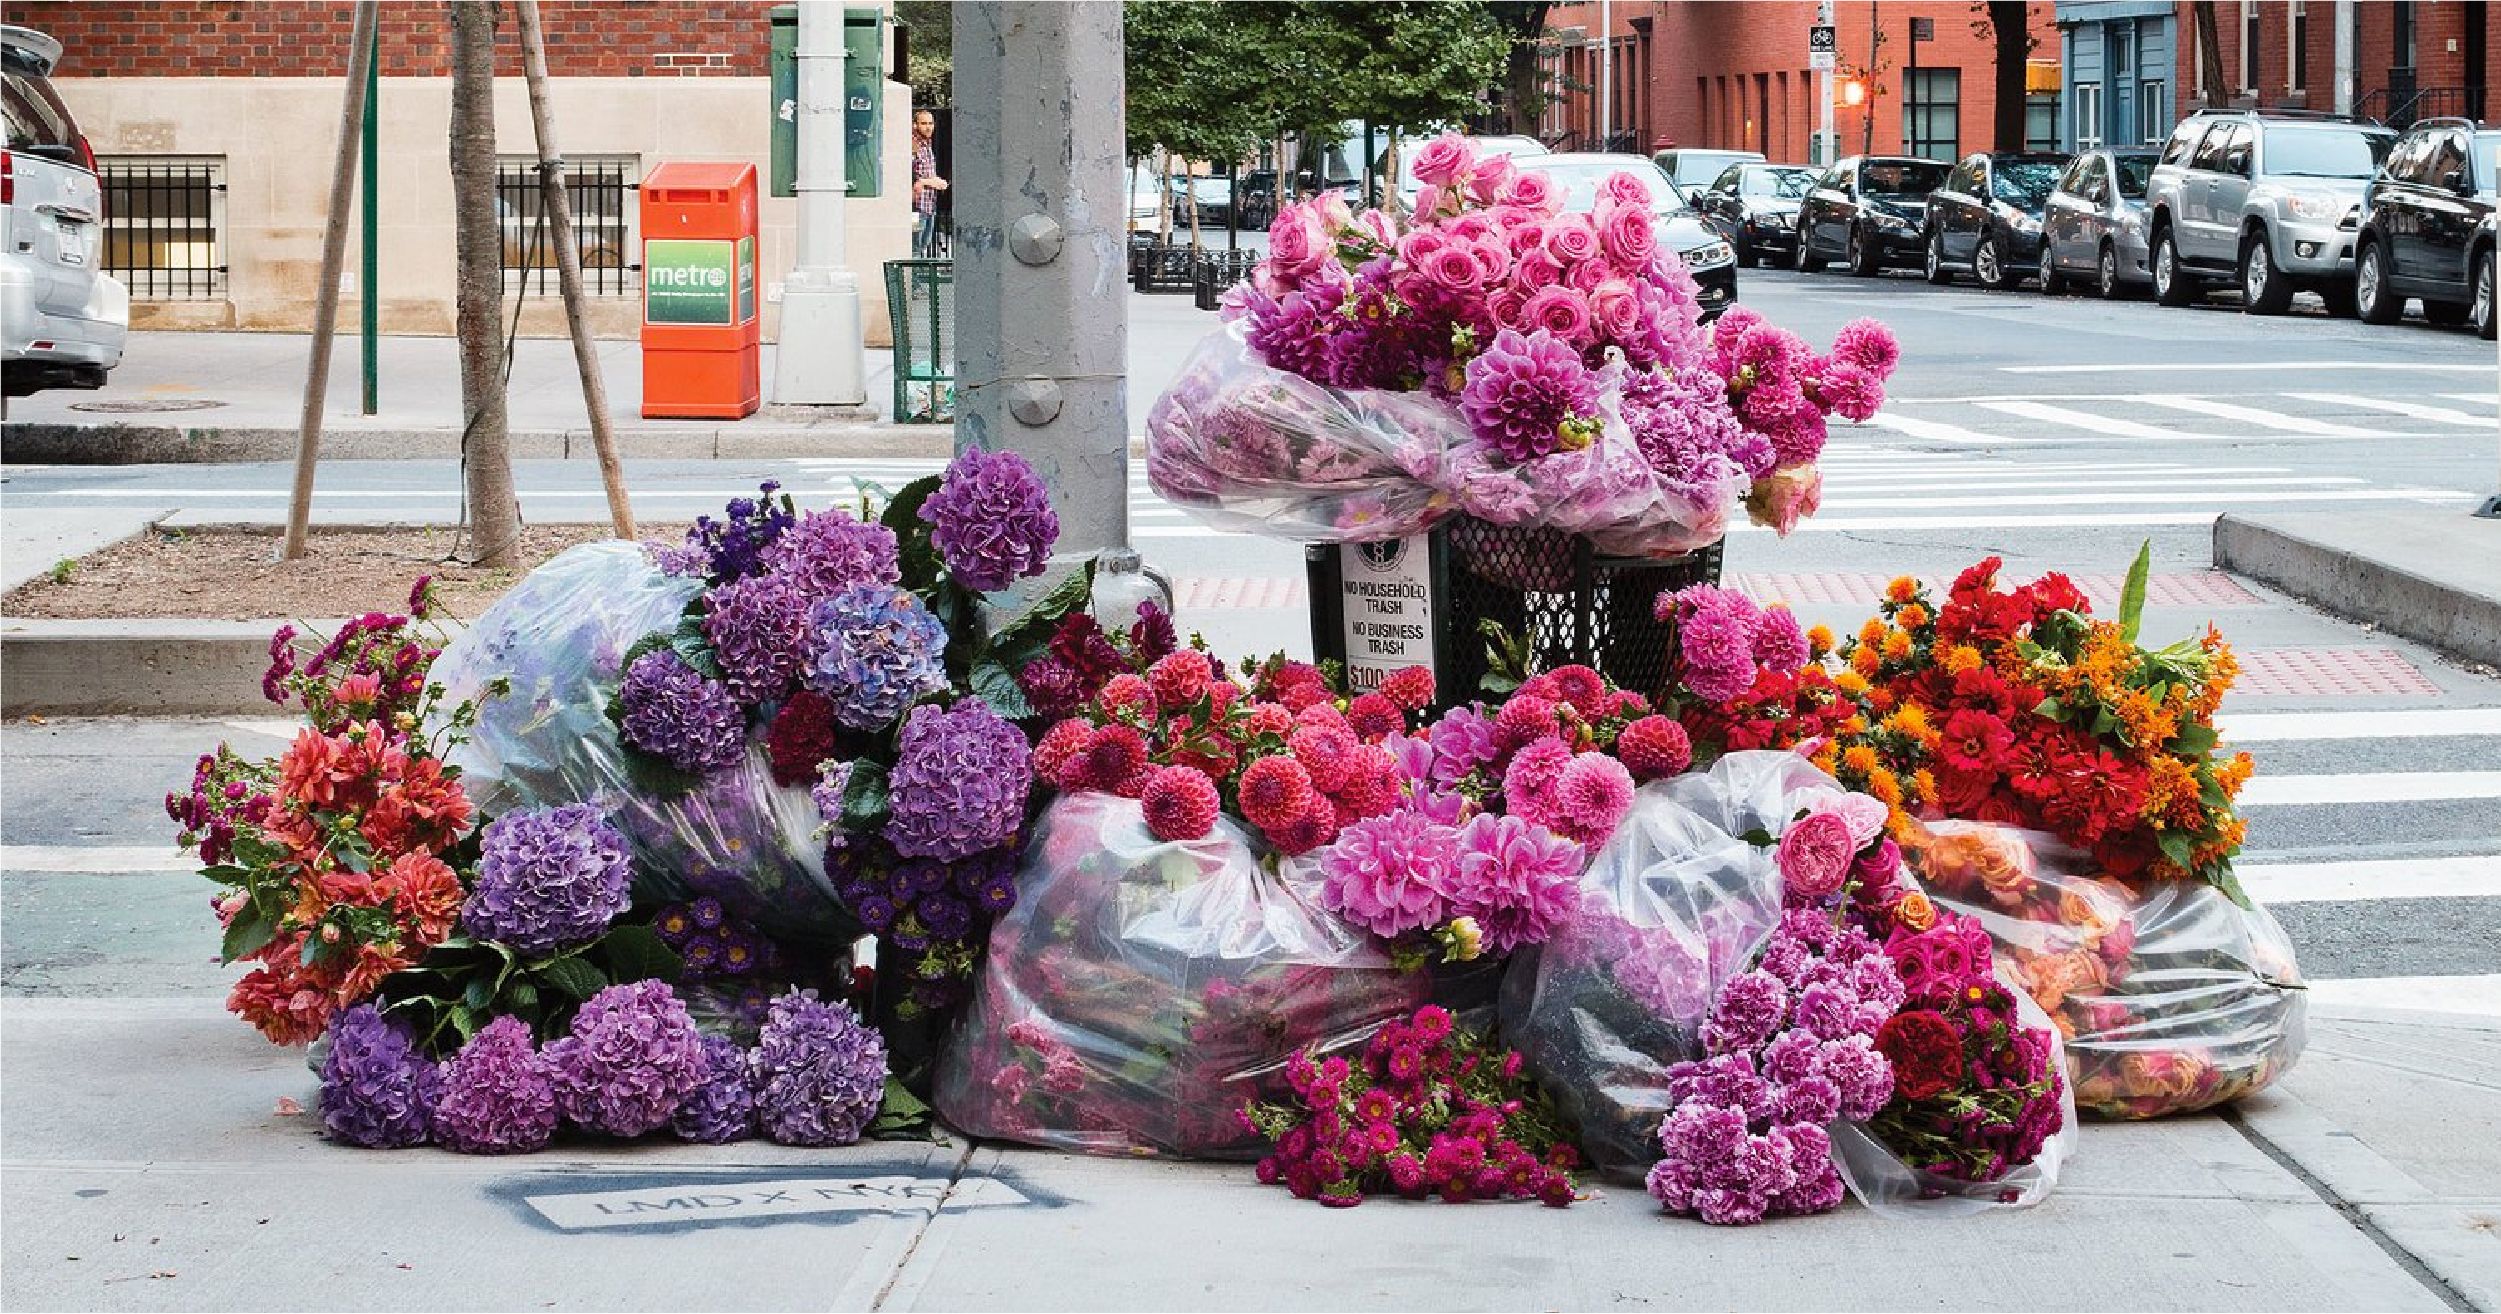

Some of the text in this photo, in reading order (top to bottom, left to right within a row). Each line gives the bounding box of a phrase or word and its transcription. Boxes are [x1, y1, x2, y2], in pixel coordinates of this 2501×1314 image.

[651, 264, 727, 287] metro
[1344, 581, 1426, 597] NO HOUSEHOLD
[1366, 599, 1403, 615] TRASH
[1353, 621, 1423, 639] NO BUSINESS
[1368, 639, 1404, 655] TRASH
[594, 1197, 742, 1214] LMD
[753, 1190, 799, 1205] X
